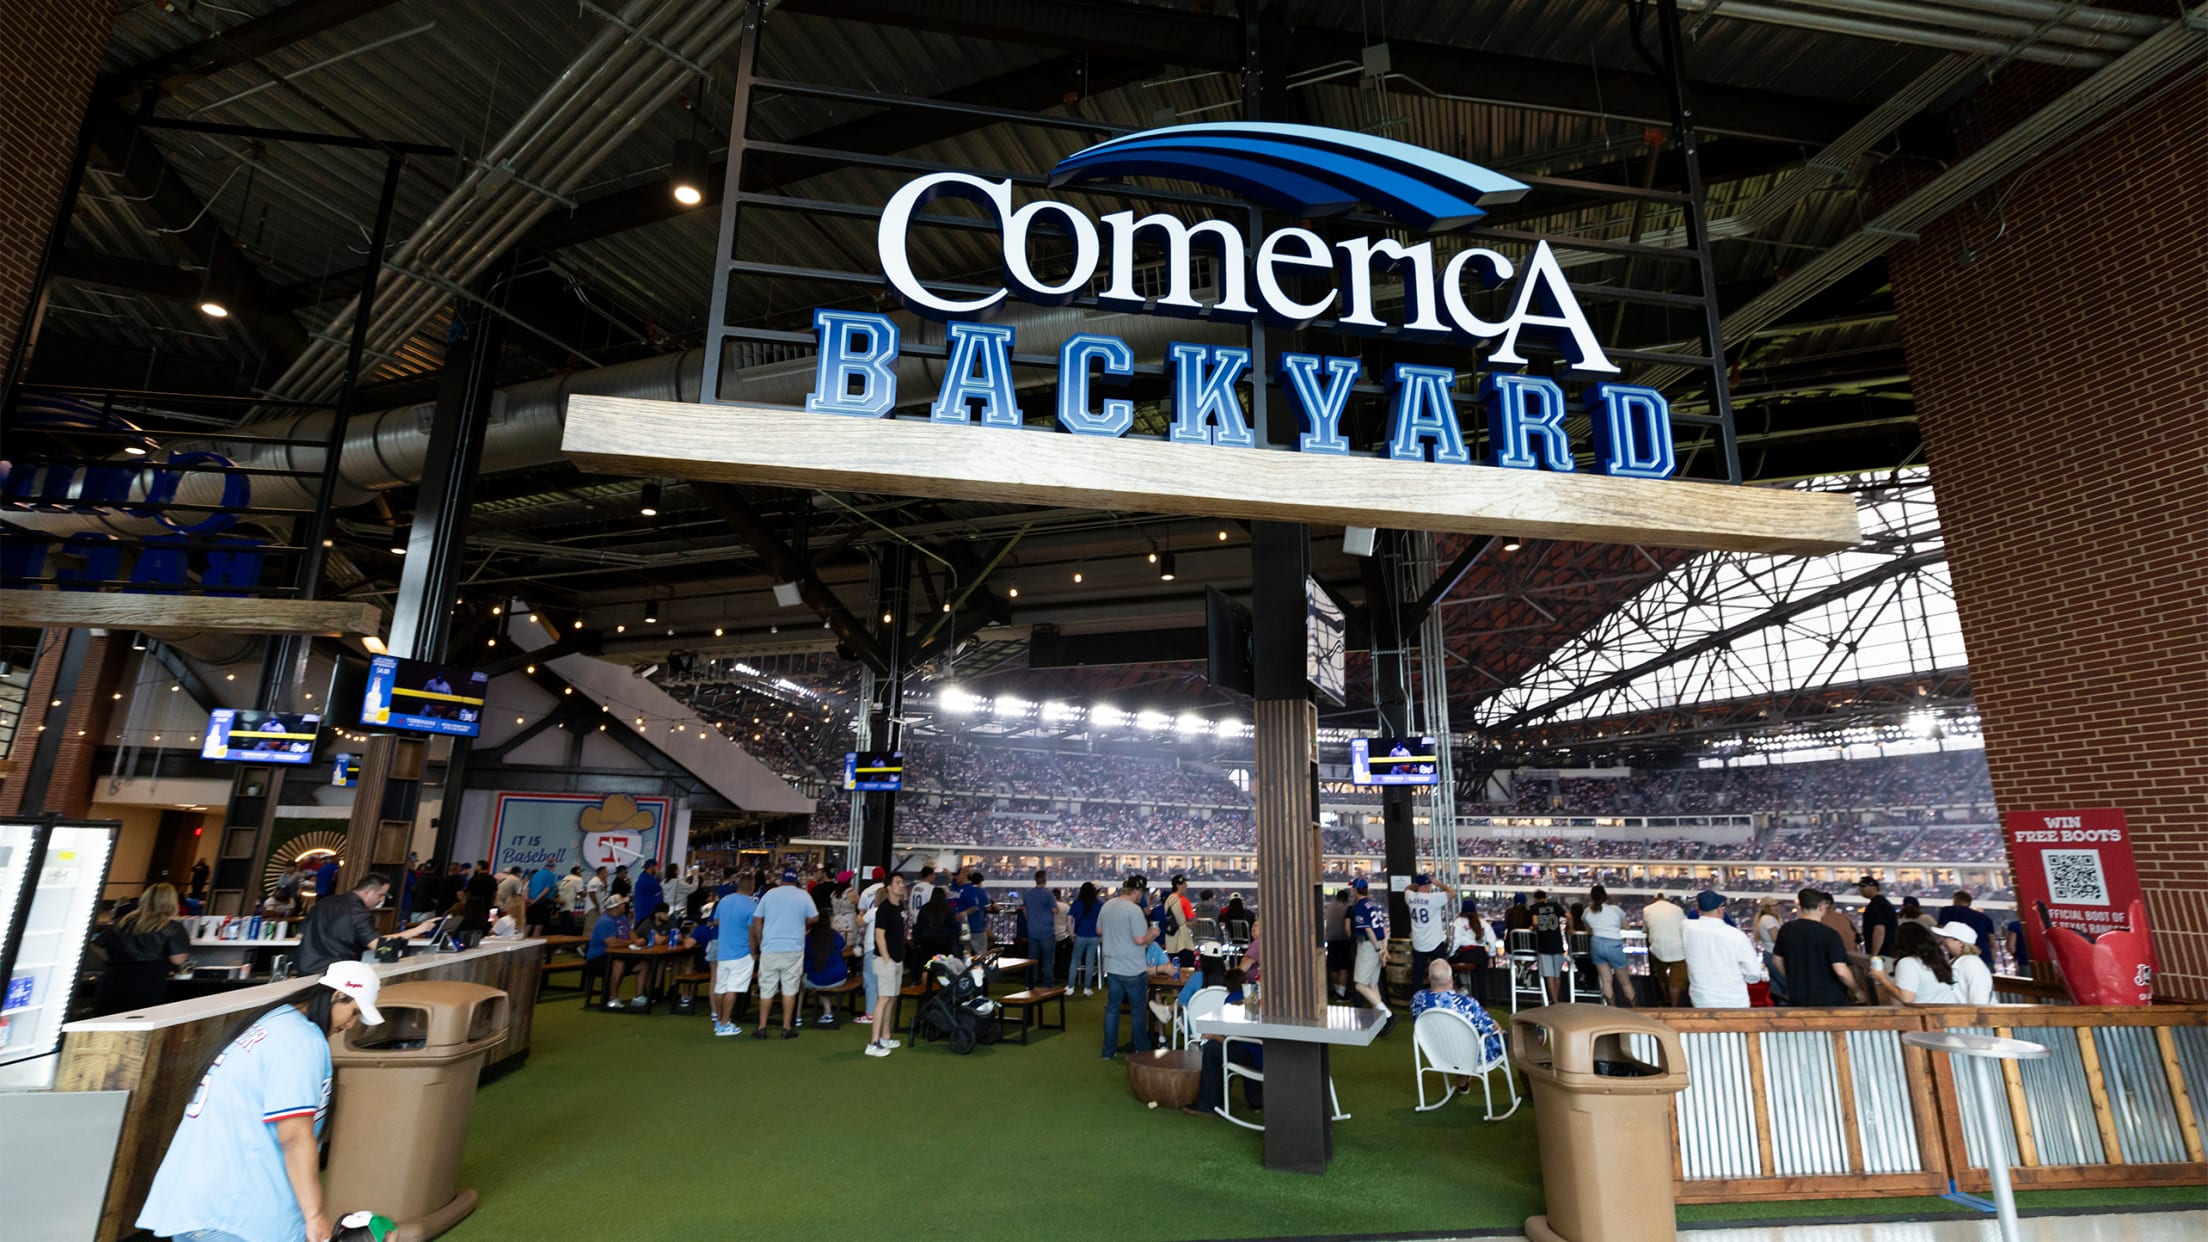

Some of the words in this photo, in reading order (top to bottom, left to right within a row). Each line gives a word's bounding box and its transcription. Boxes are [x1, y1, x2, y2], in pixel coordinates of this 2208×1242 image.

[806, 308, 1676, 480] BACKYARD
[2043, 816, 2082, 829] WIN
[511, 835, 526, 846] IT
[528, 835, 542, 846] IS
[2015, 831, 2058, 843] FREE
[2060, 829, 2122, 843] BOOTS
[502, 847, 568, 864] Baseball
[1410, 907, 1429, 924] 48
[2047, 908, 2084, 921] FFICIAL
[2085, 910, 2110, 922] BOOT
[2112, 911, 2125, 923] OF
